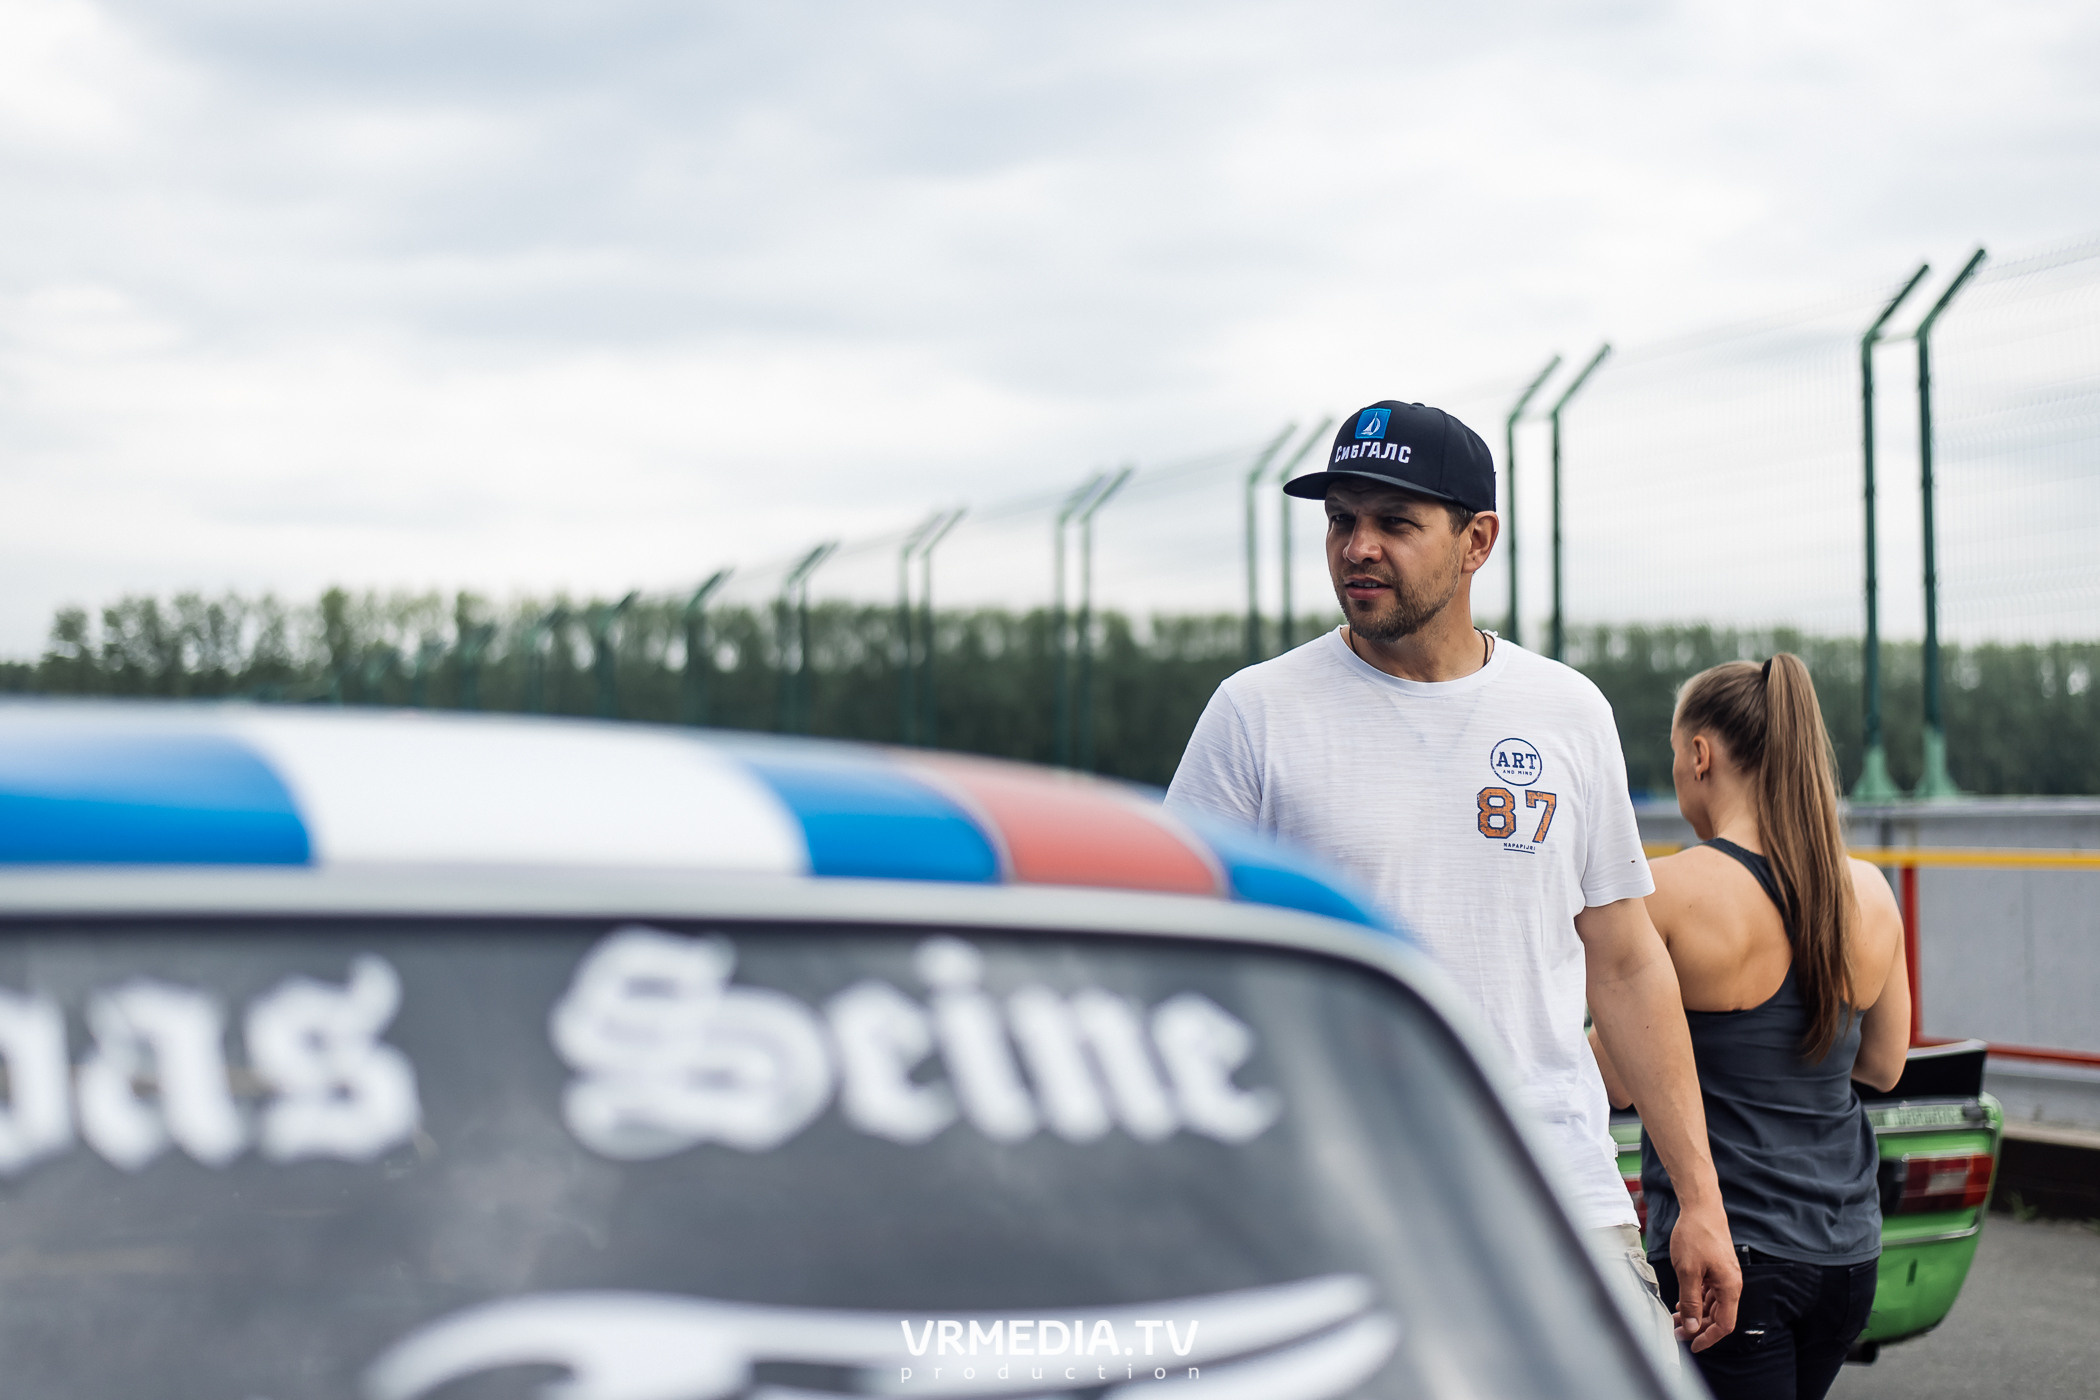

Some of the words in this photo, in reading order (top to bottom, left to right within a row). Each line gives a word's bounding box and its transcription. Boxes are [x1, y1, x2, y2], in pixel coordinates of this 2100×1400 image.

[1496, 751, 1537, 770] ART
[1477, 786, 1557, 844] 87
[1503, 842, 1536, 851] NAPAPIJRI
[551, 926, 1280, 1160] Seine
